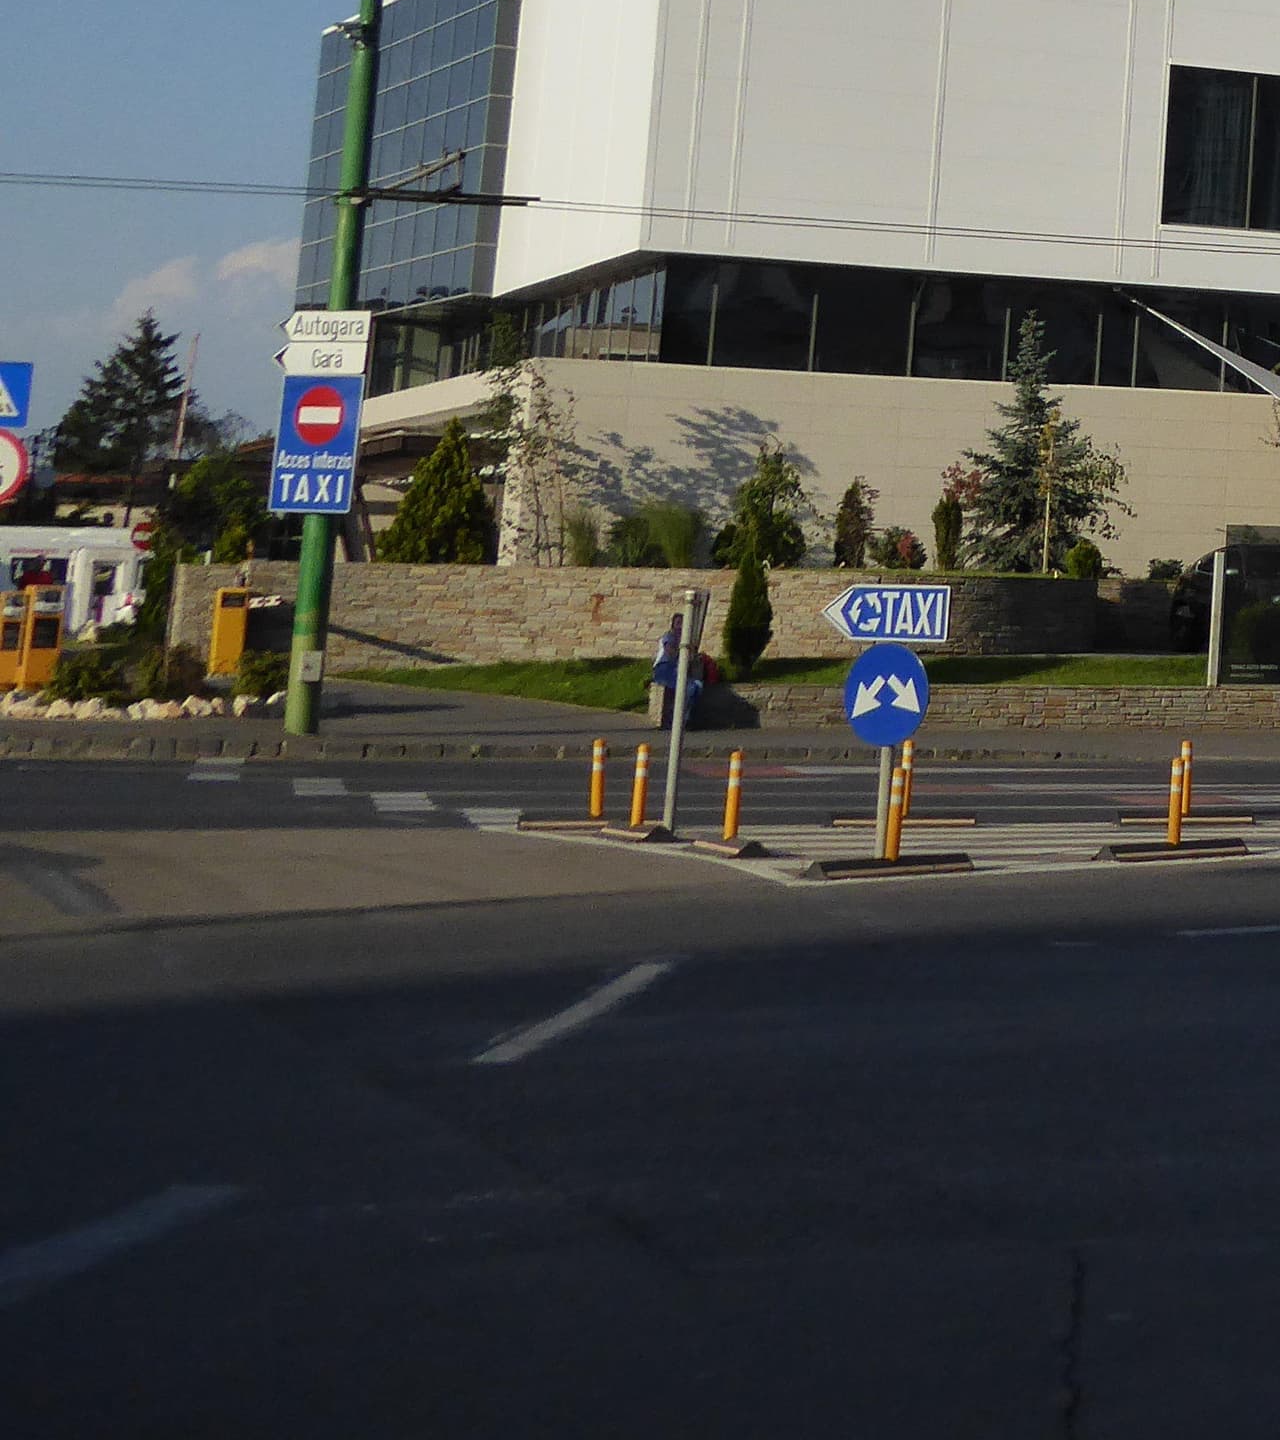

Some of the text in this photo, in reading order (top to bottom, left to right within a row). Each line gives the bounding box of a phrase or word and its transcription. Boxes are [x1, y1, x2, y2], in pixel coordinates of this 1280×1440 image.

[293, 315, 365, 342] Autogara
[277, 449, 352, 470] Acces interzis
[280, 473, 345, 504] TAXI
[882, 591, 944, 635] TAXI
